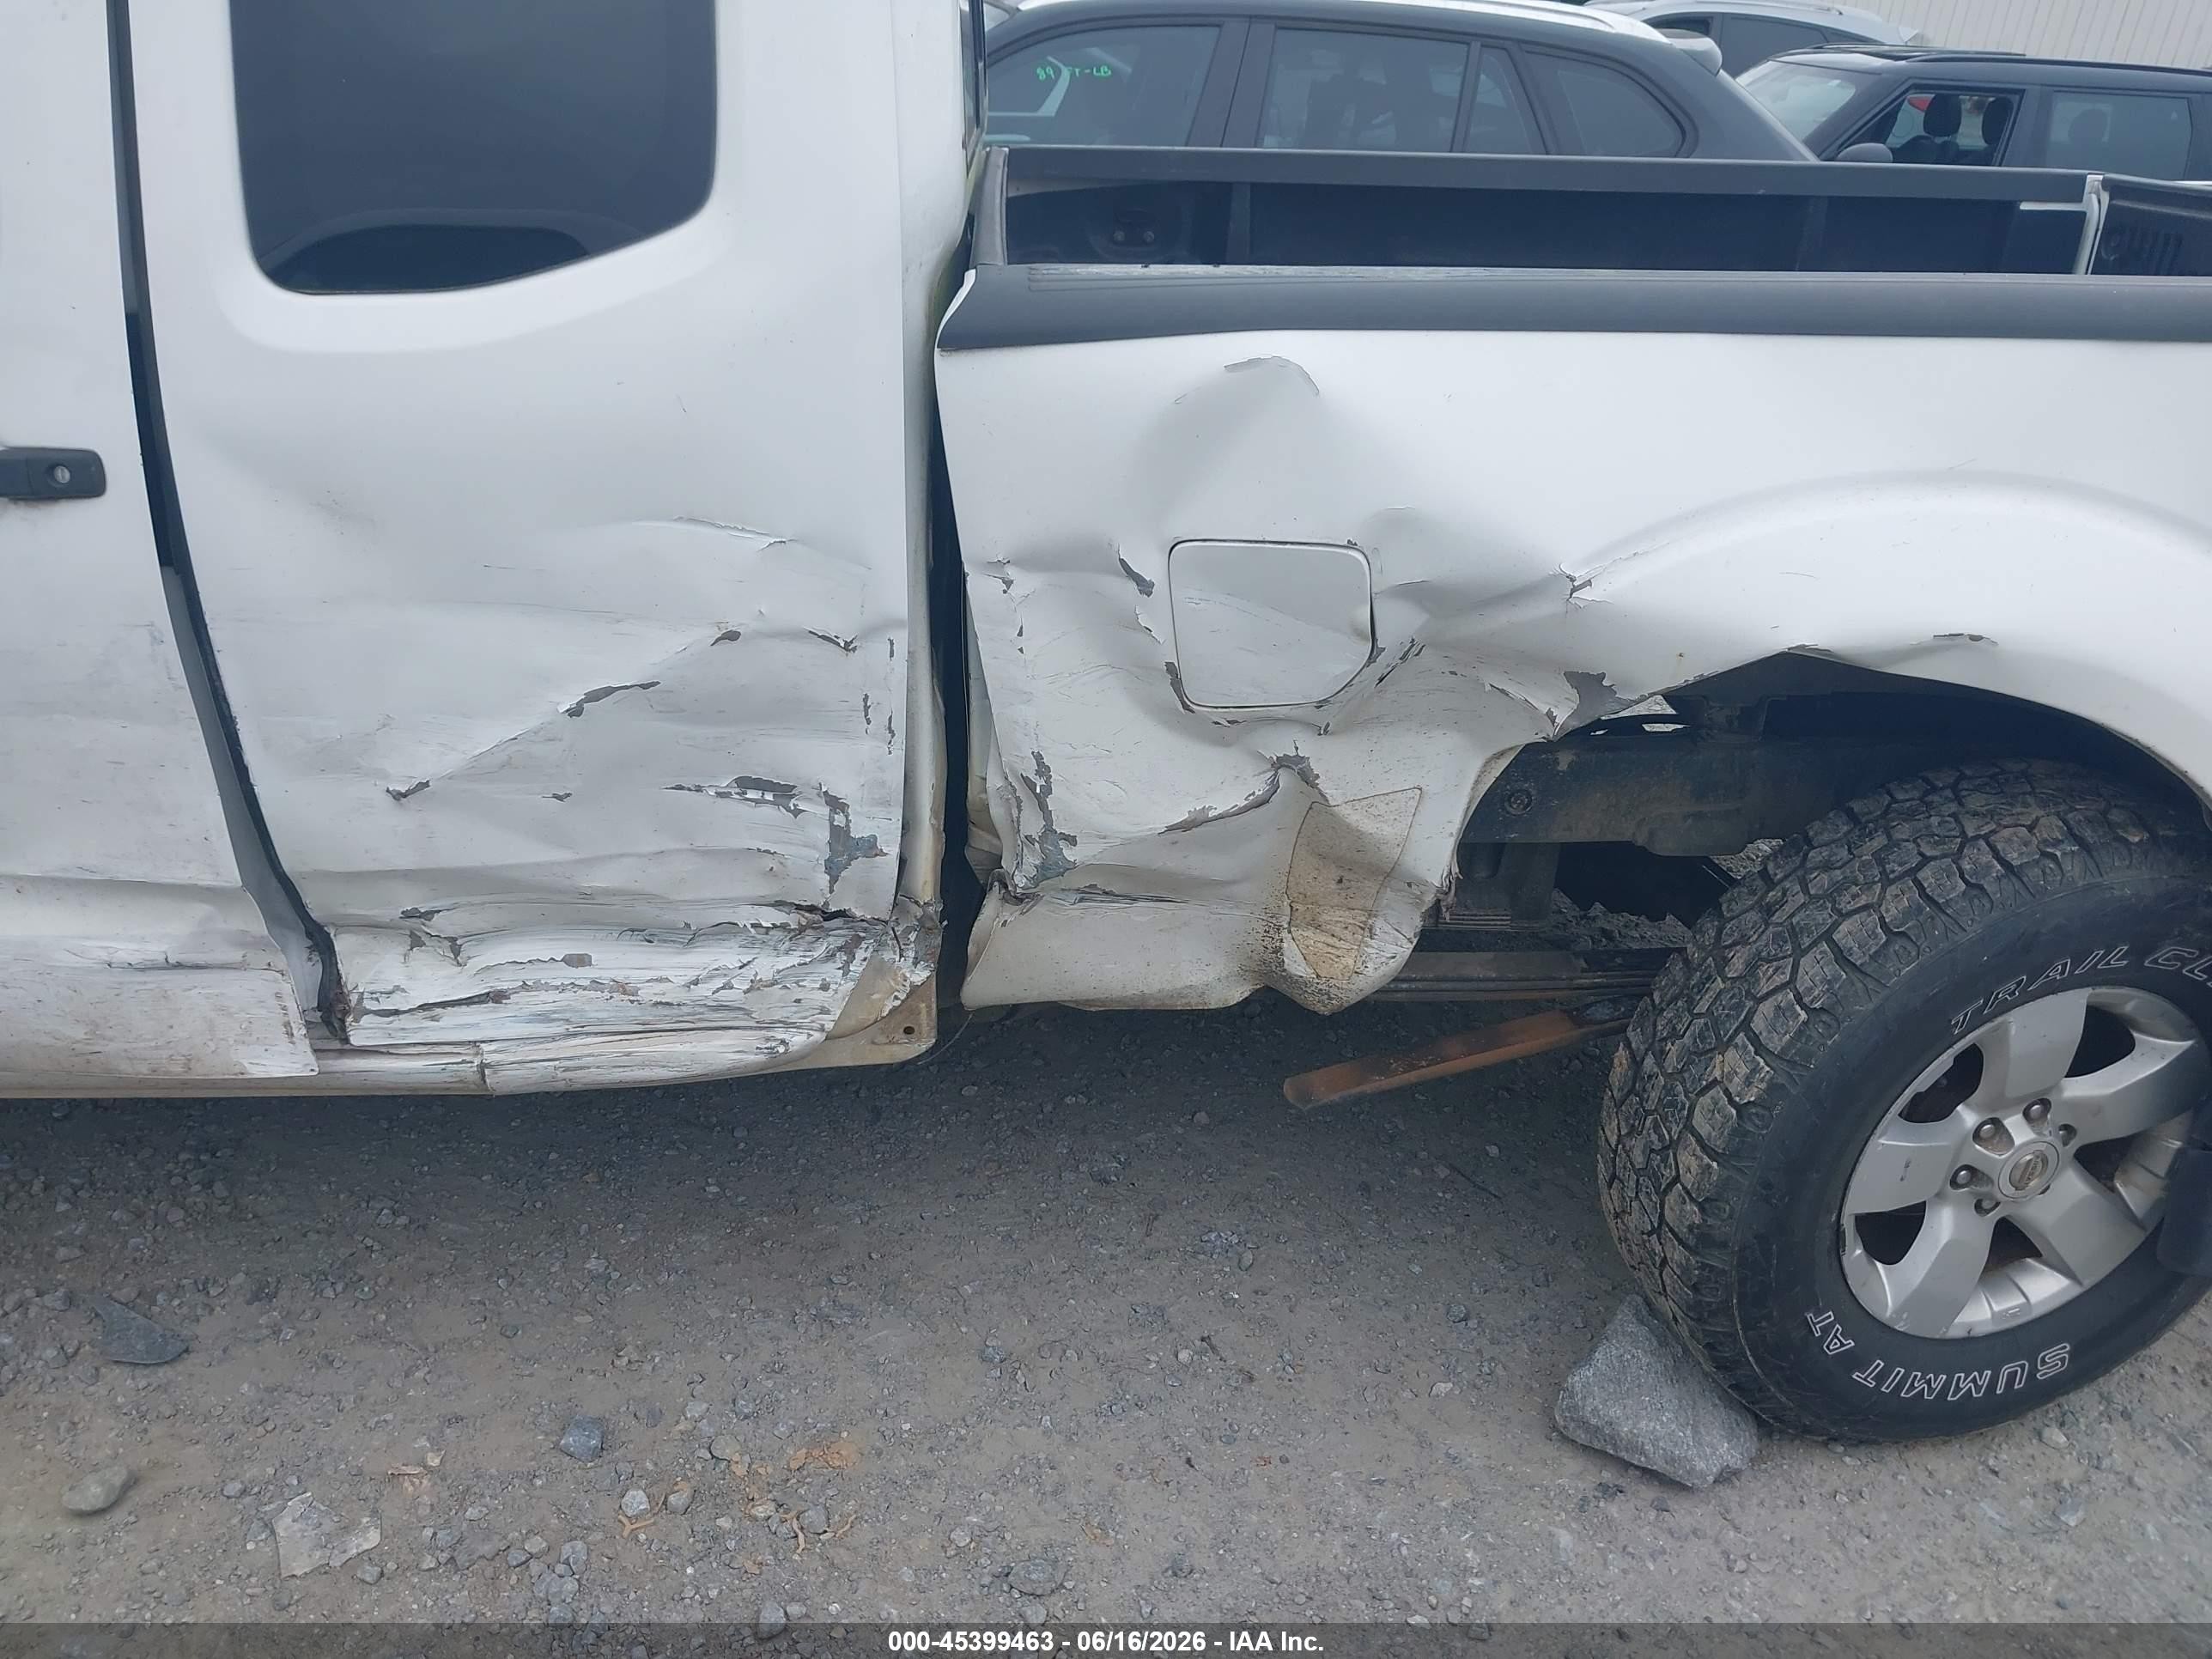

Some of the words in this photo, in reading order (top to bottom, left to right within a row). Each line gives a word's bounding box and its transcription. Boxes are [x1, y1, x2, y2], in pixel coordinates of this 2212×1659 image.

[1950, 945, 2130, 1035] TRAIL
[2143, 946, 2212, 988] CL
[1805, 1310, 1856, 1355] AT
[1852, 1342, 2071, 1401] SUMMIT
